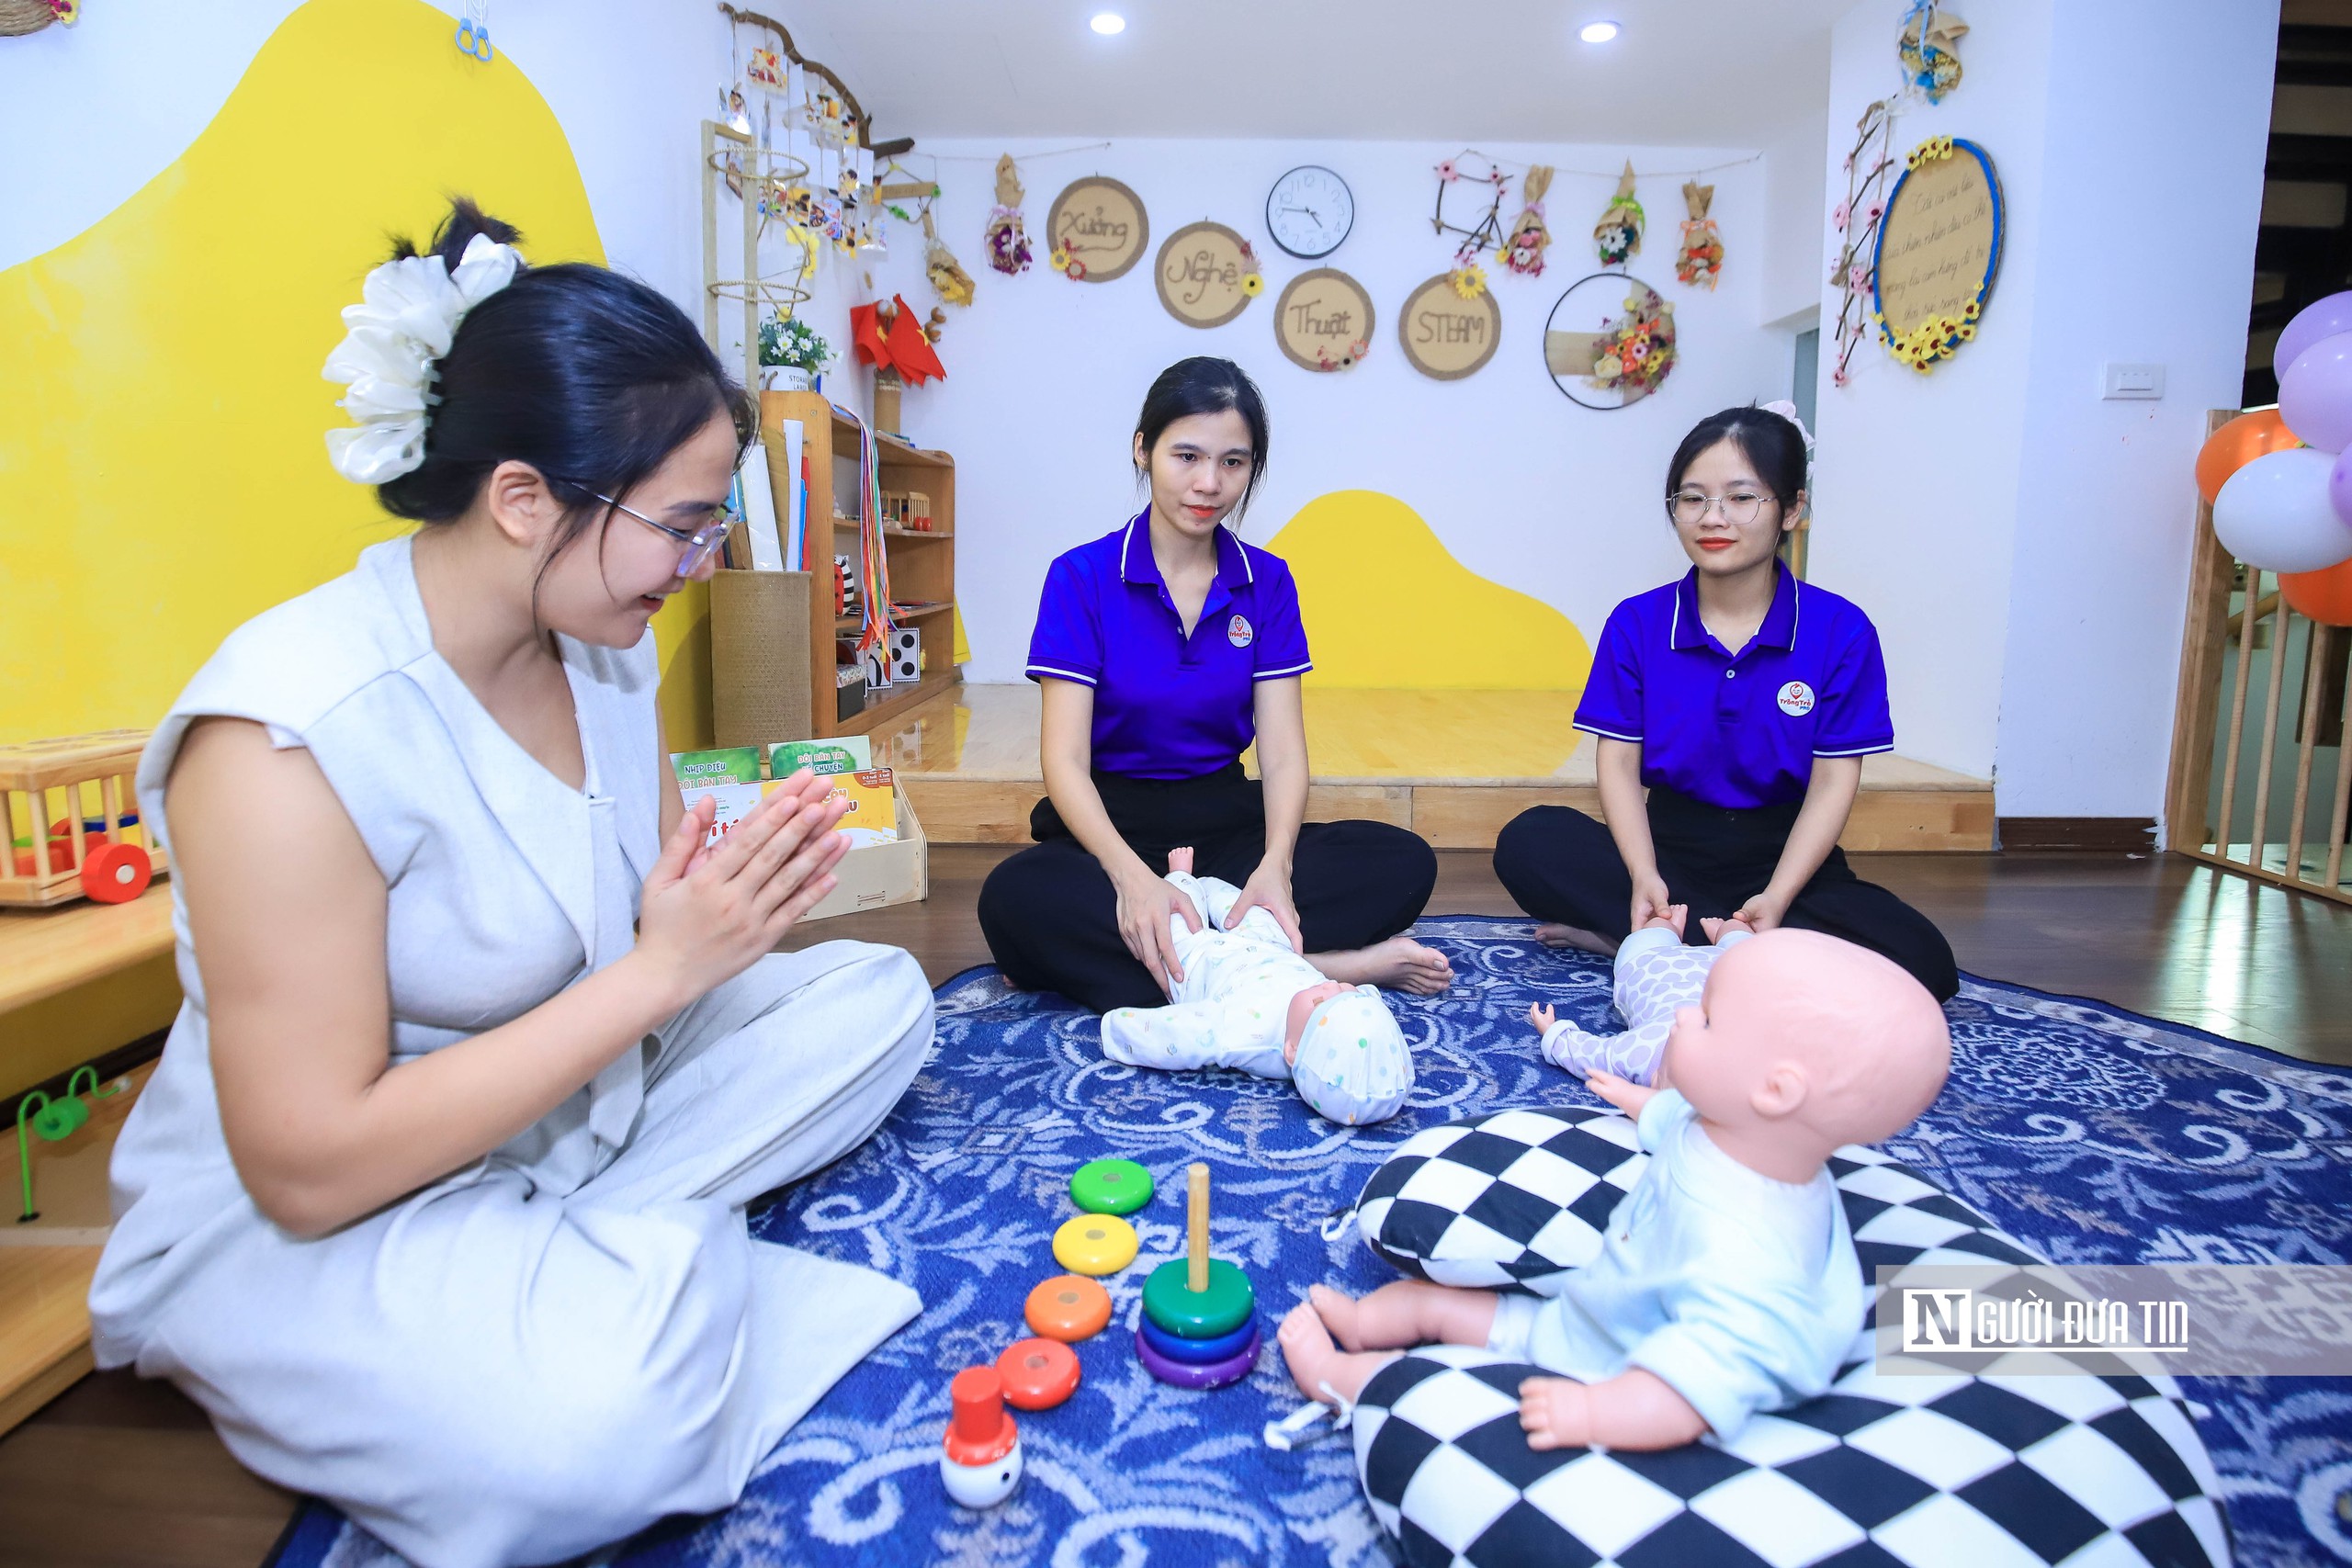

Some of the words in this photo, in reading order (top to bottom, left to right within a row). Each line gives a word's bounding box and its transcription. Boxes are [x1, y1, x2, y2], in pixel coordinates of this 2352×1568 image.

[1166, 250, 1238, 304] Nghệ
[1289, 299, 1351, 340] Thuật
[1416, 311, 1485, 344] STEAM
[814, 752, 830, 761] BÀN
[831, 751, 845, 760] TAY
[815, 762, 843, 773] CHUYỆN
[718, 775, 737, 785] TAY
